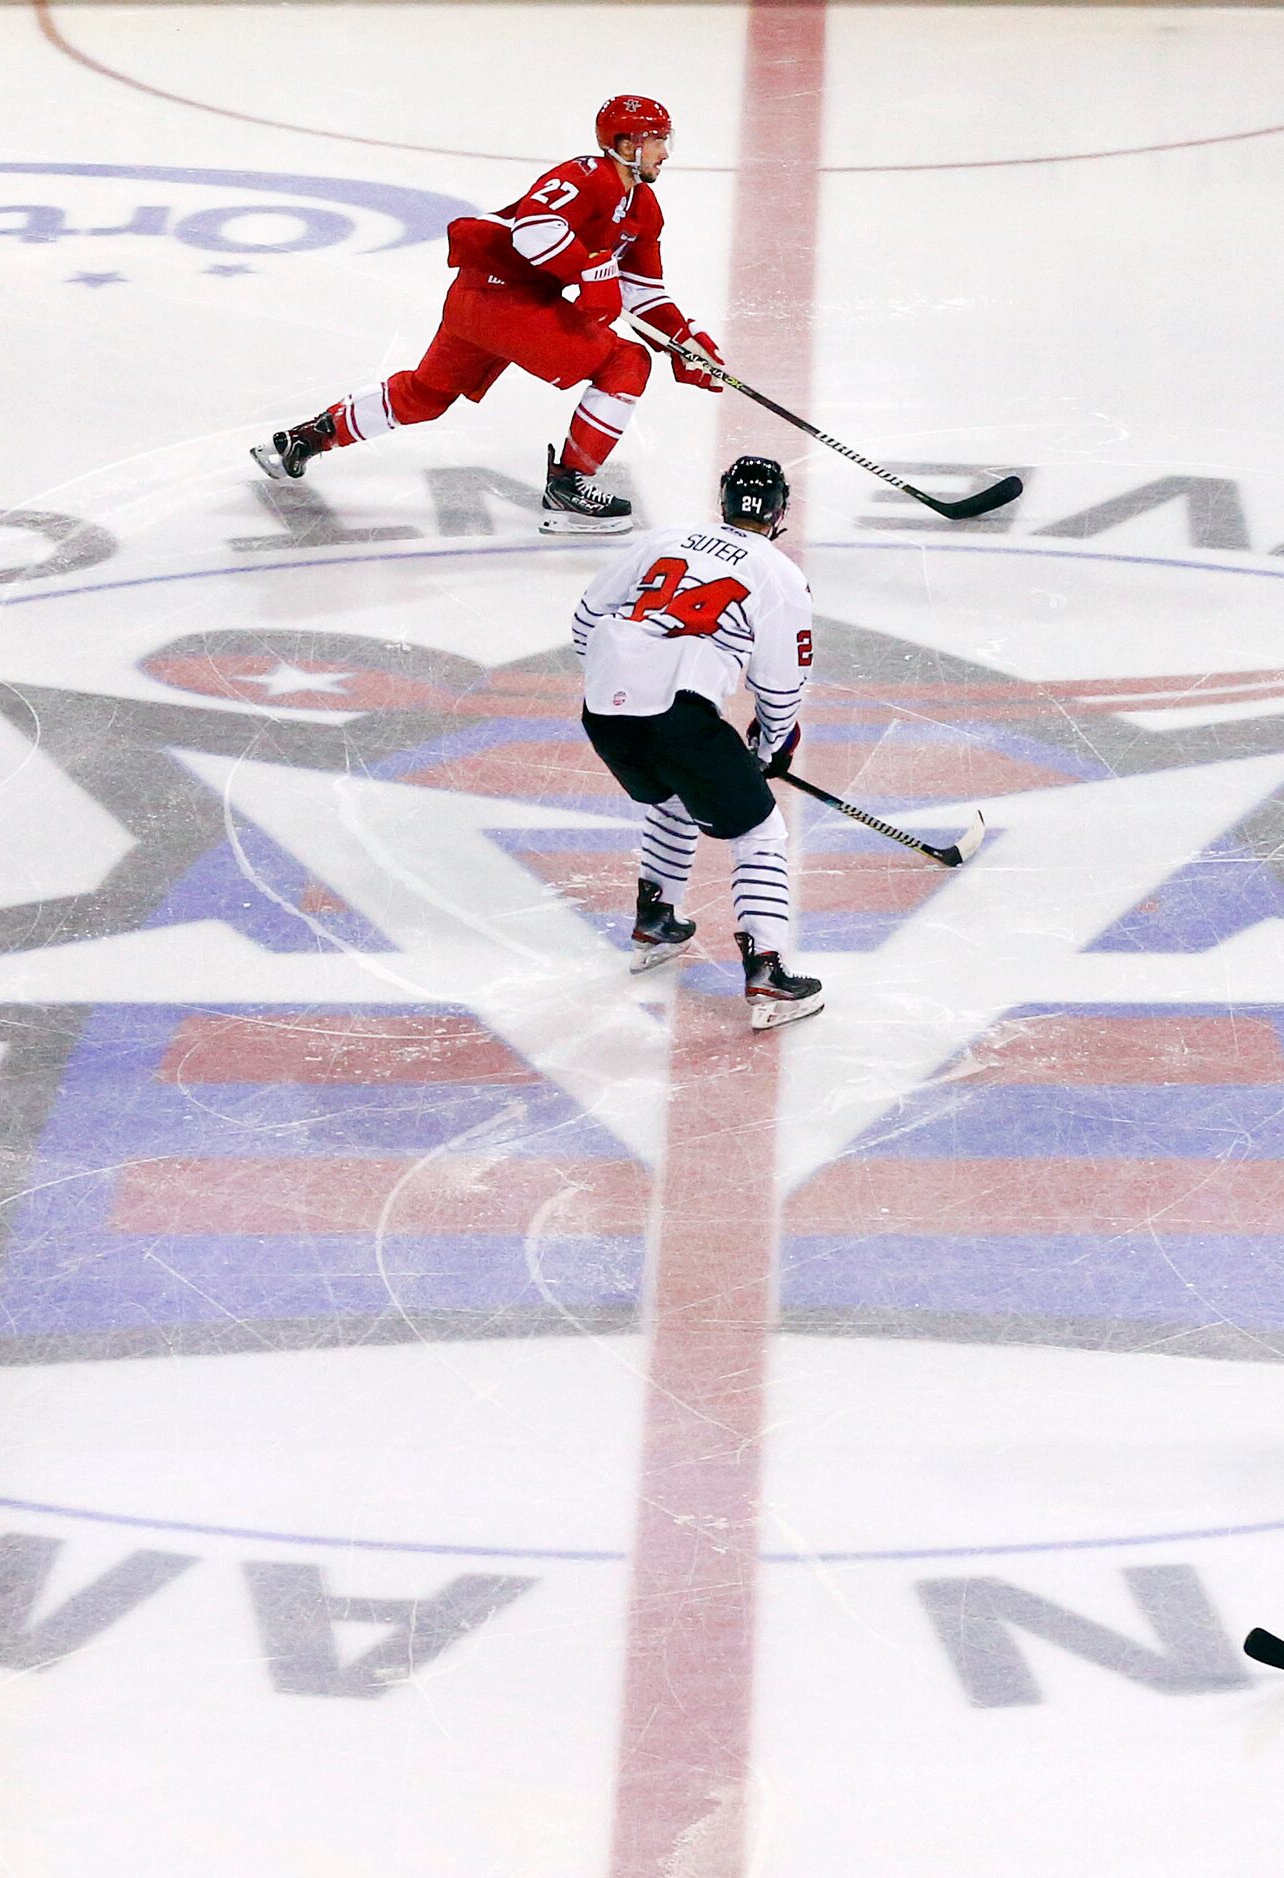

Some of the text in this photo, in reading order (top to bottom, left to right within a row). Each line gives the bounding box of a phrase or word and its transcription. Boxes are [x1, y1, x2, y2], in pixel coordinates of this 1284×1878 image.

[530, 178, 579, 211] 27
[816, 431, 907, 490] WARRIOR
[741, 495, 762, 515] 24
[680, 533, 748, 566] SUTER
[625, 556, 752, 638] 24
